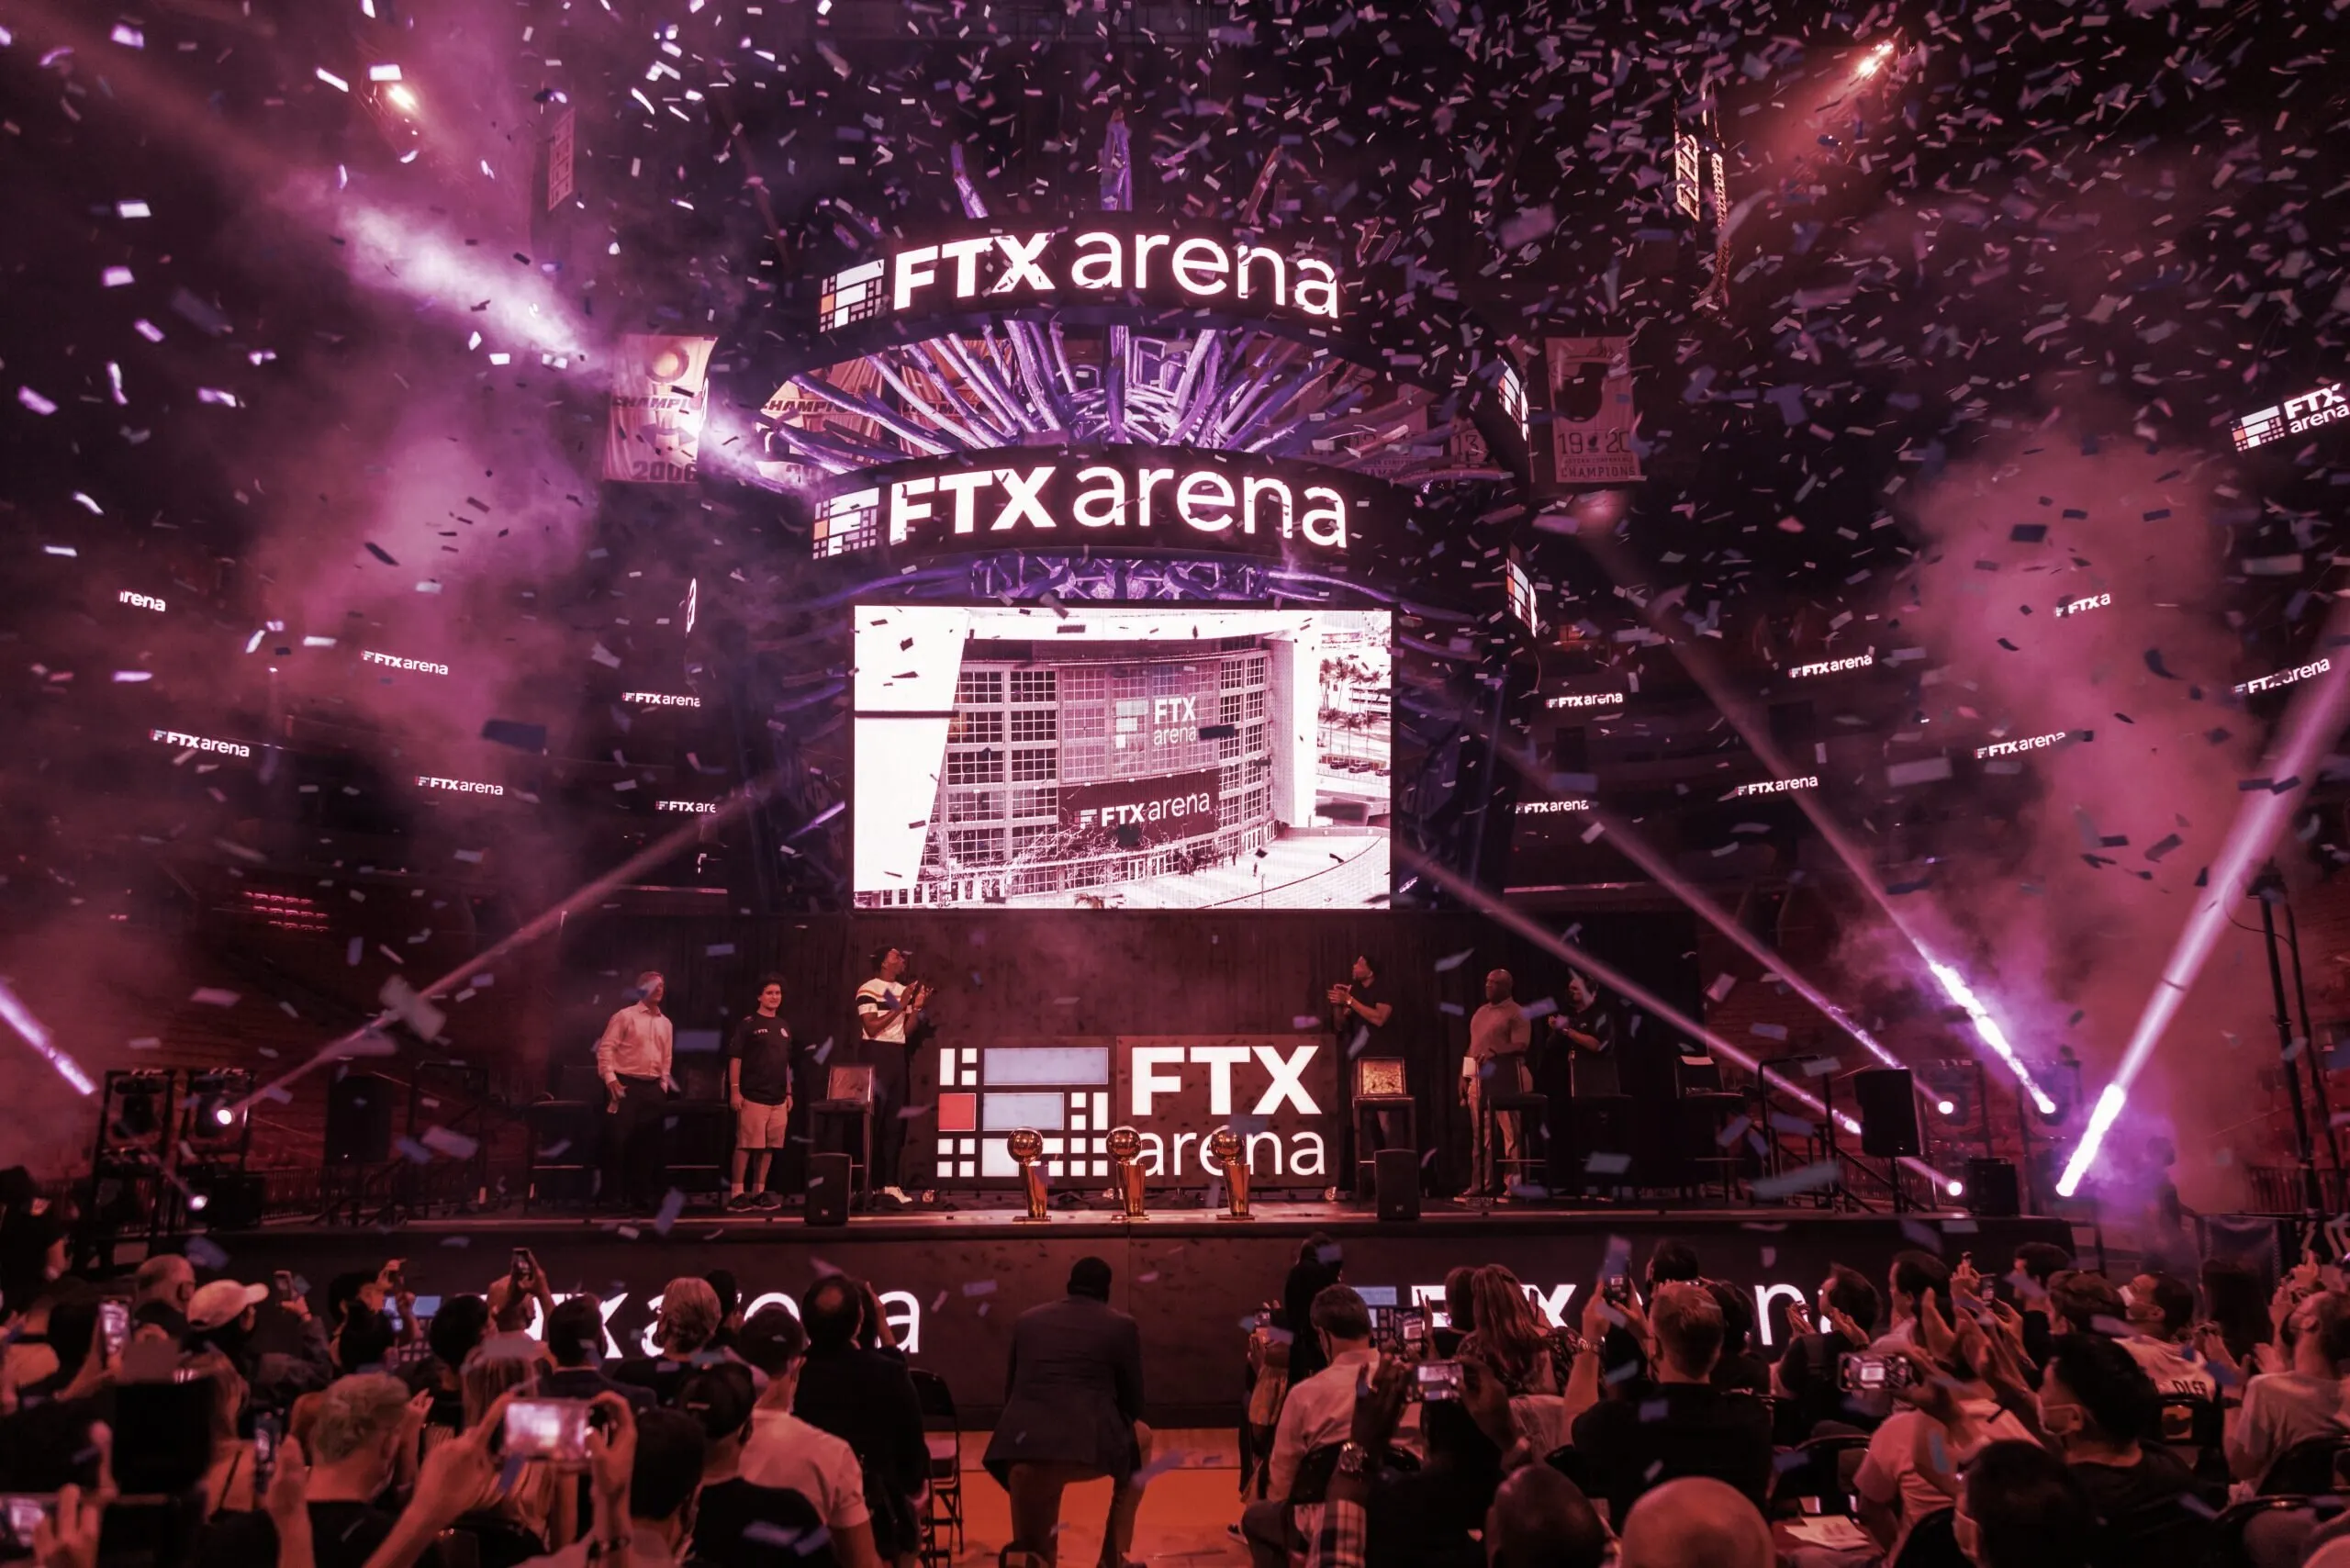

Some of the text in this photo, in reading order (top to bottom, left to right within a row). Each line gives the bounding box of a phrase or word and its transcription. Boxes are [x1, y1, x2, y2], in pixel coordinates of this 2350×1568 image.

[893, 231, 1338, 319] FTX arena
[2284, 383, 2350, 433] FTX arena
[632, 461, 699, 482] 2006
[1561, 465, 1636, 478] CHAMPIONS
[890, 465, 1348, 548] FTX arena
[2068, 595, 2100, 614] FTX
[375, 653, 449, 675] FTX arena
[1803, 655, 1873, 677] FTX arena
[635, 692, 661, 704] FTX
[1559, 692, 1624, 708] FTX arena
[1154, 696, 1197, 725] FTX
[167, 731, 250, 757] FTX arena
[1153, 725, 1197, 745] arena
[1988, 741, 2019, 757] FTX
[430, 777, 504, 796] FTX arena
[1748, 776, 1818, 795] FTX arena
[669, 801, 694, 812] FTX
[1102, 792, 1210, 827] FTX arena
[1524, 802, 1550, 814] FTX
[1131, 1046, 1323, 1116] FTX
